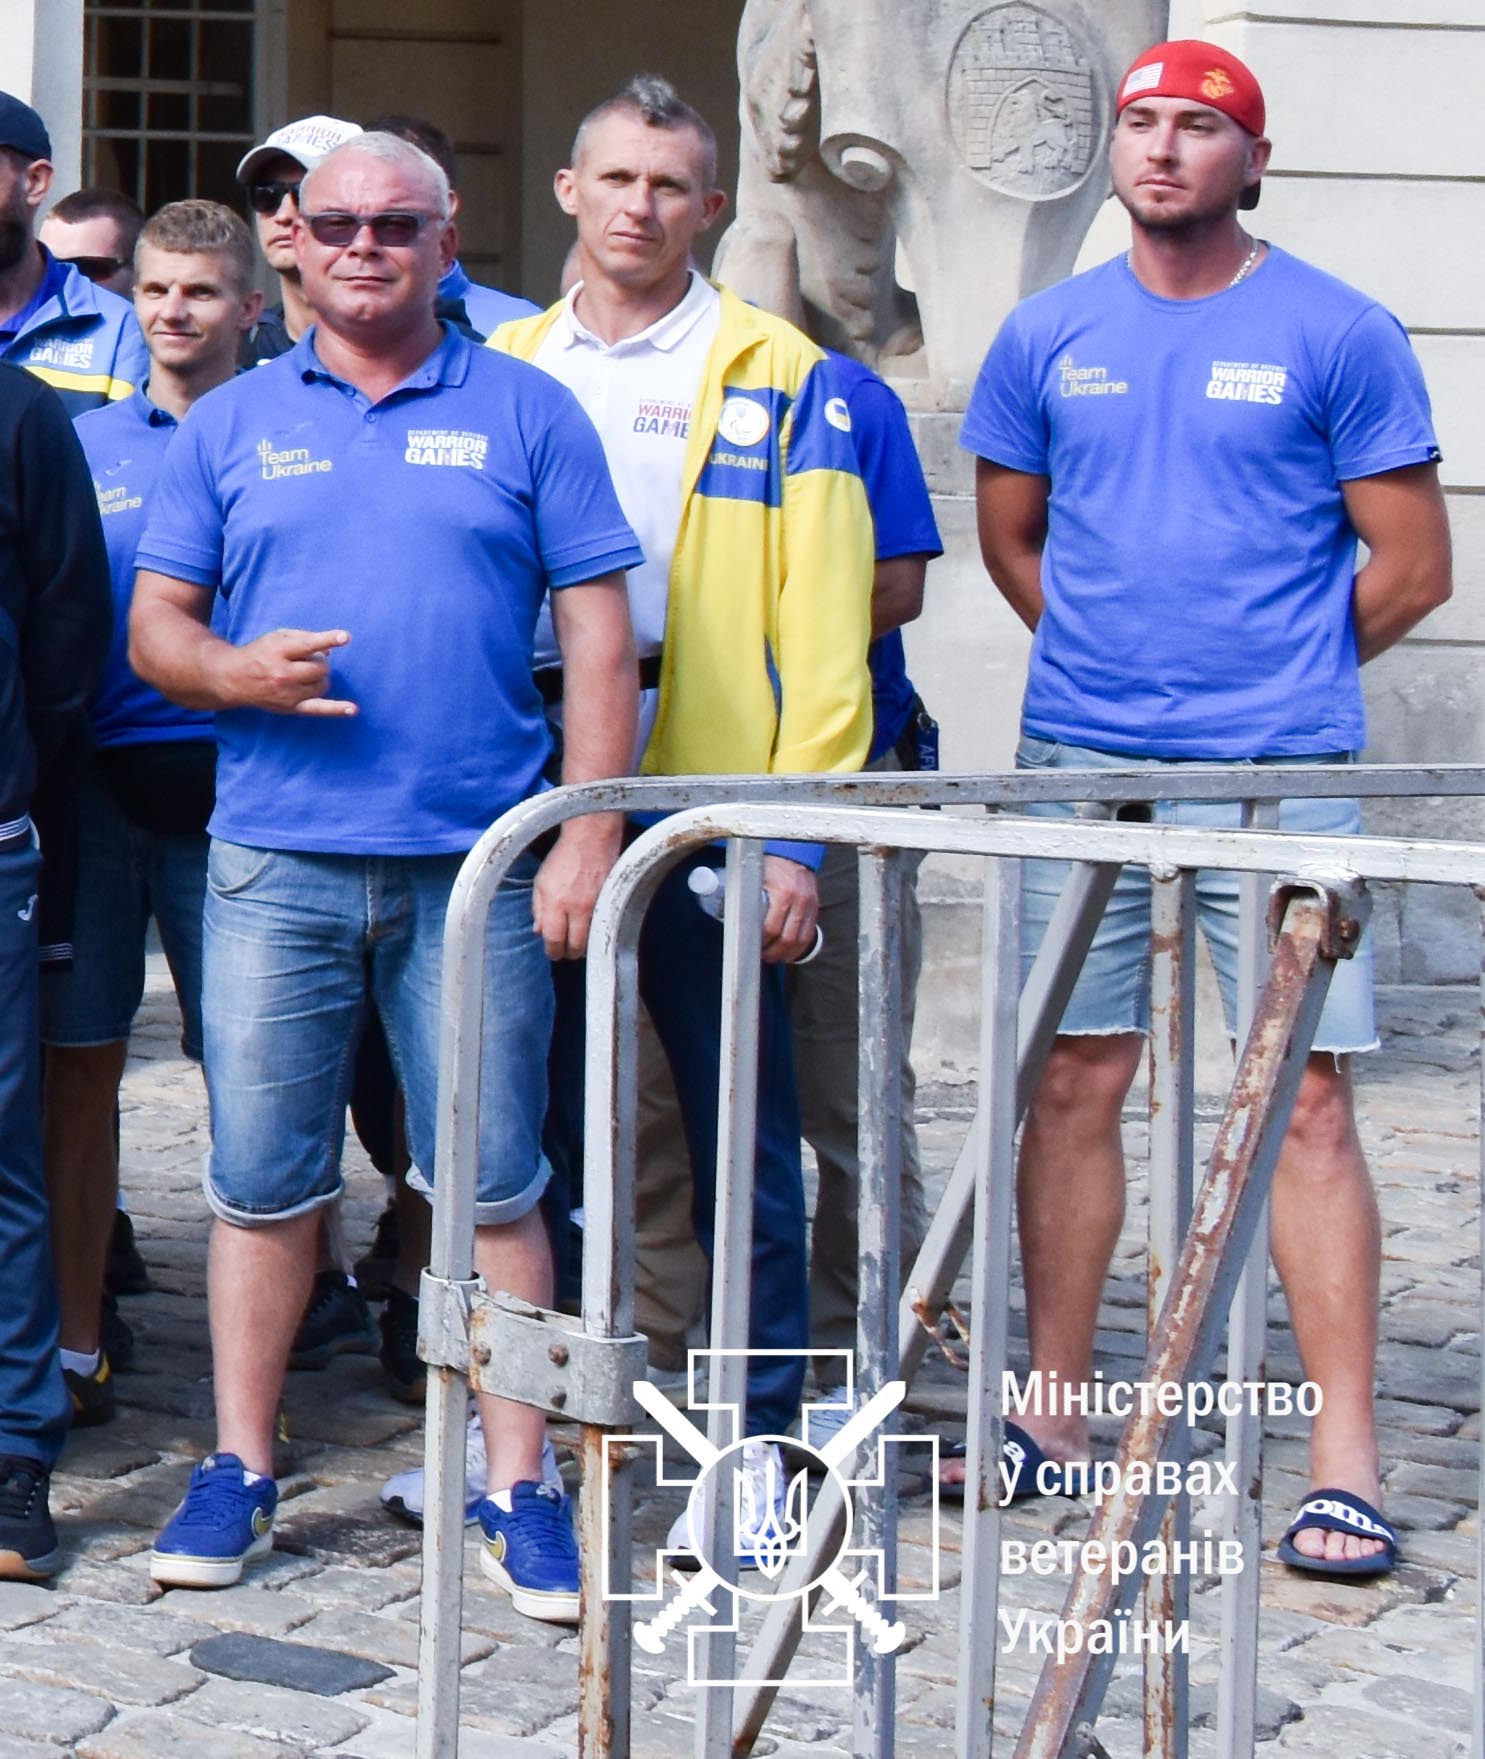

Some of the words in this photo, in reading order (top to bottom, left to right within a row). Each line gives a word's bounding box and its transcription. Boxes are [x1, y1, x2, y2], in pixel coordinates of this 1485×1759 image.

[30, 347, 92, 369] GAMES
[1059, 365, 1107, 382] Team
[1212, 367, 1287, 387] WARRIOR
[1060, 381, 1128, 398] Ukraine
[1206, 380, 1284, 405] GAMES
[638, 403, 692, 421] WARRI
[633, 416, 689, 440] GAME
[408, 435, 488, 455] WARRIOR
[260, 448, 310, 466] Team
[405, 448, 486, 470] GAMES
[709, 453, 769, 471] UKRAIN
[262, 459, 333, 481] Ukraine
